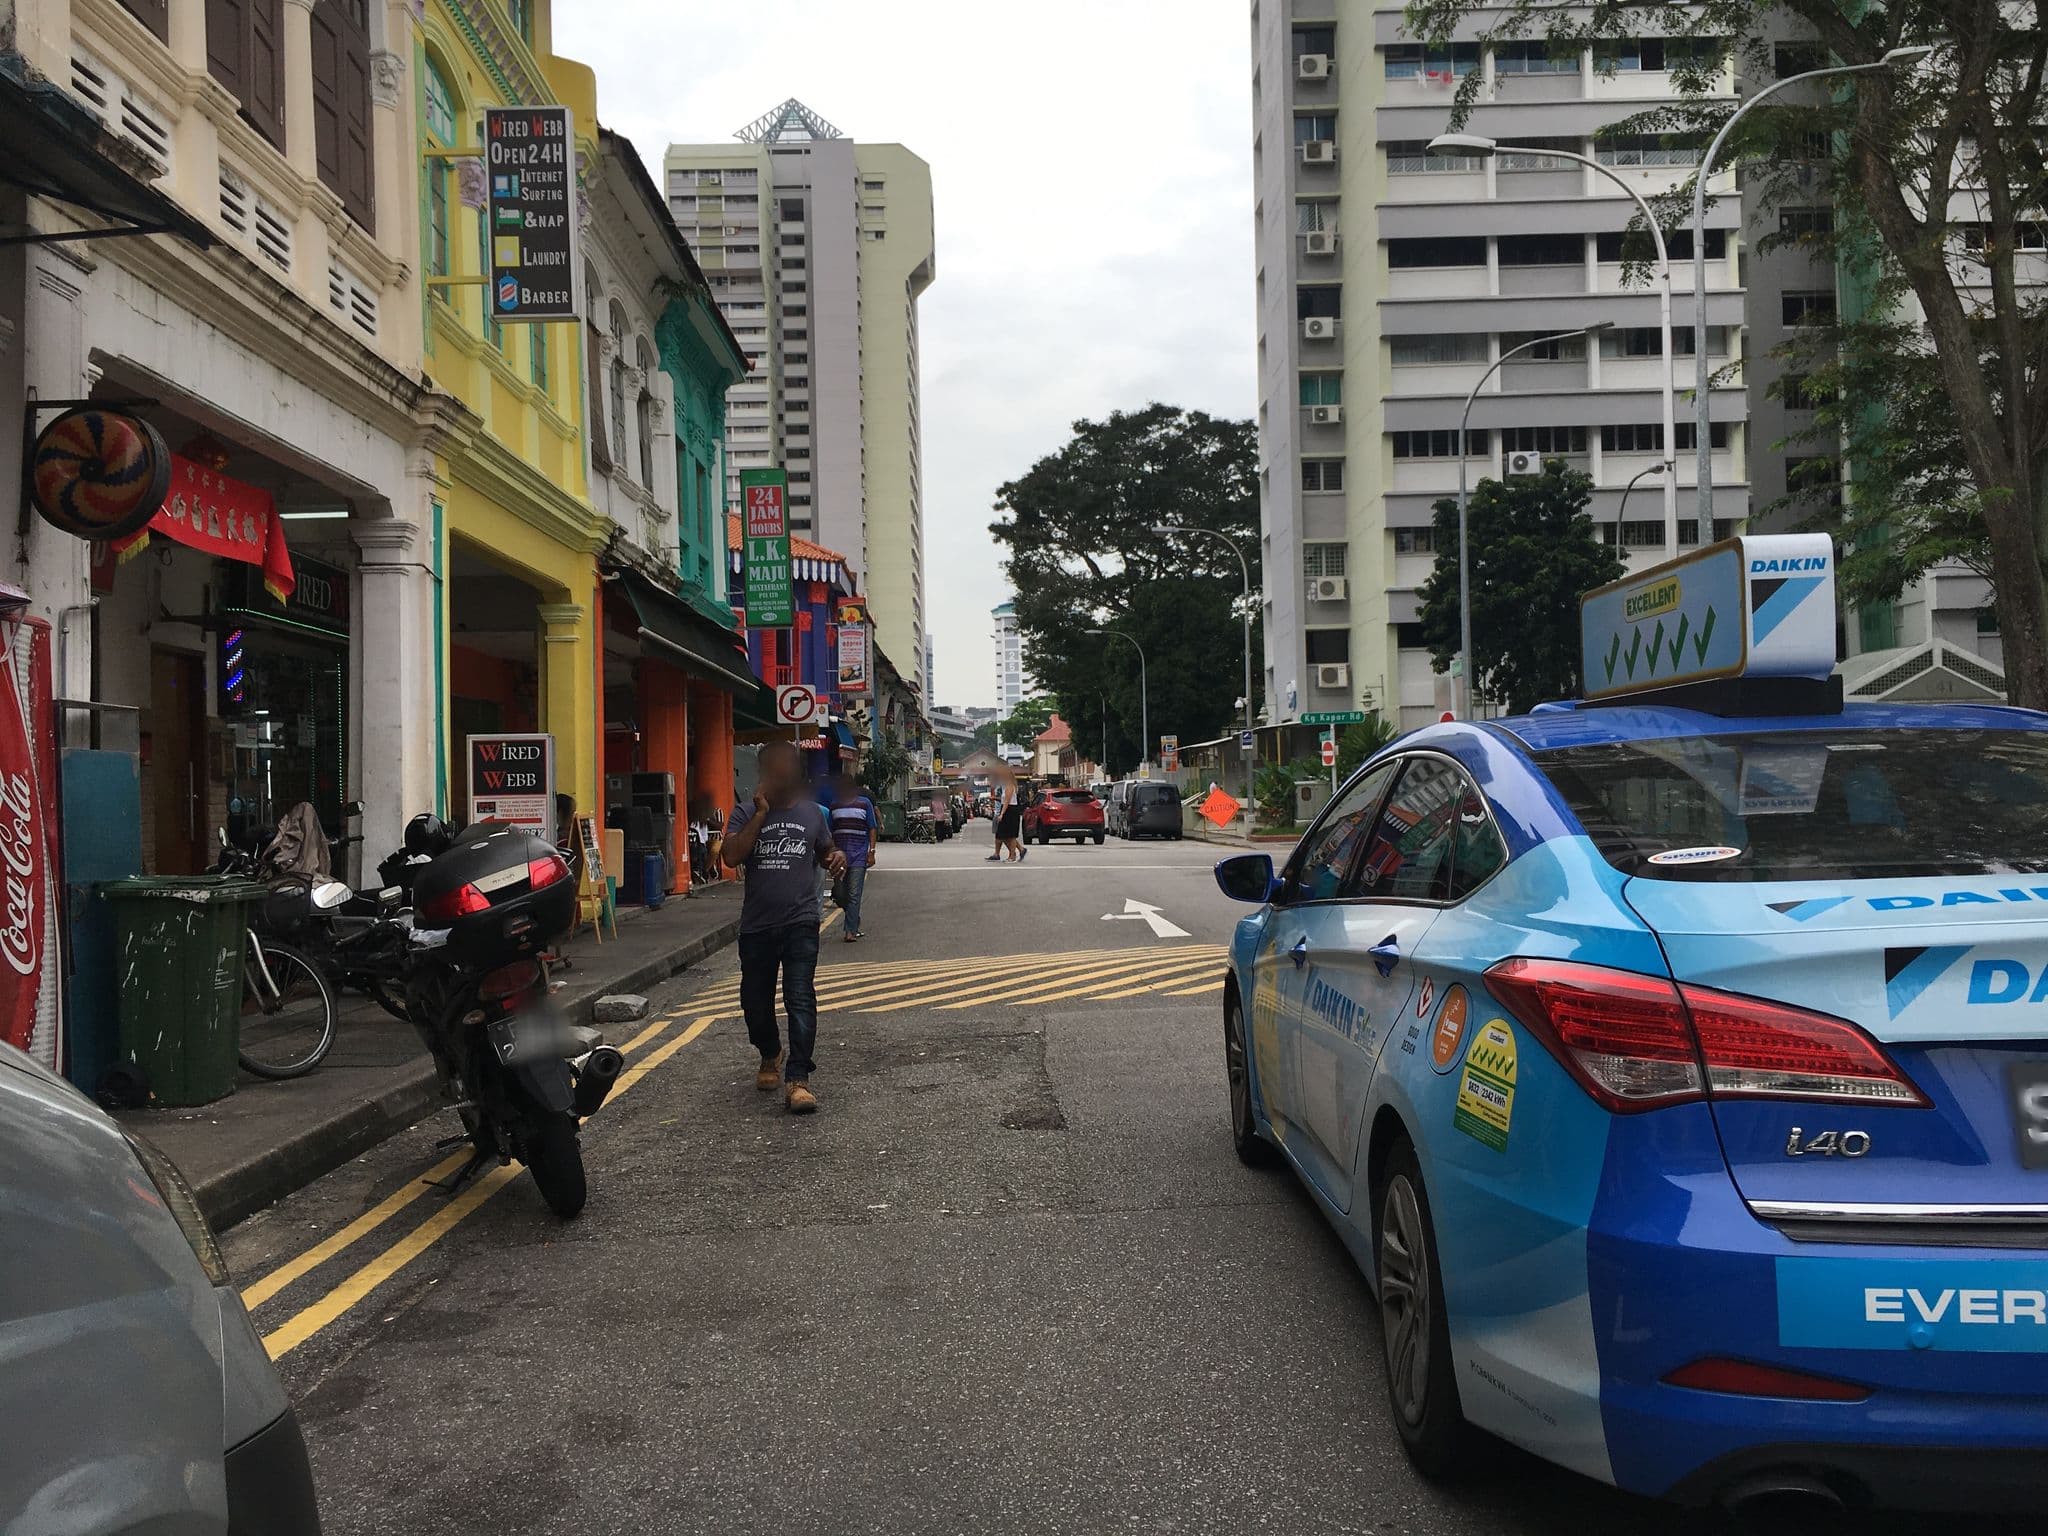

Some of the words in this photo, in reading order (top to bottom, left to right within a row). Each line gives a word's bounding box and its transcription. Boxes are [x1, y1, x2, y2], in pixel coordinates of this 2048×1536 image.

[532, 114, 563, 137] WEBB
[520, 167, 563, 183] INTERNET
[521, 187, 563, 201] SURFING
[524, 247, 567, 266] LAUNDRY
[521, 287, 569, 304] BARBER
[755, 488, 774, 504] 24
[750, 505, 780, 521] JAM
[750, 522, 782, 535] HOURS
[748, 540, 786, 561] L.K.
[748, 565, 787, 583] MAJU
[1751, 557, 1827, 573] DAIKIN
[296, 573, 331, 609] IRED
[1626, 585, 1677, 617] EXCELLENT
[1304, 714, 1316, 723] Kg
[1319, 712, 1346, 722] Kapor
[1349, 712, 1361, 721] Rd
[482, 771, 537, 789] WEBB
[1205, 801, 1235, 813] CAUTION
[1866, 888, 2048, 911] DAI
[1312, 979, 1356, 1039] DAIKIN
[1786, 1126, 1872, 1158] i40
